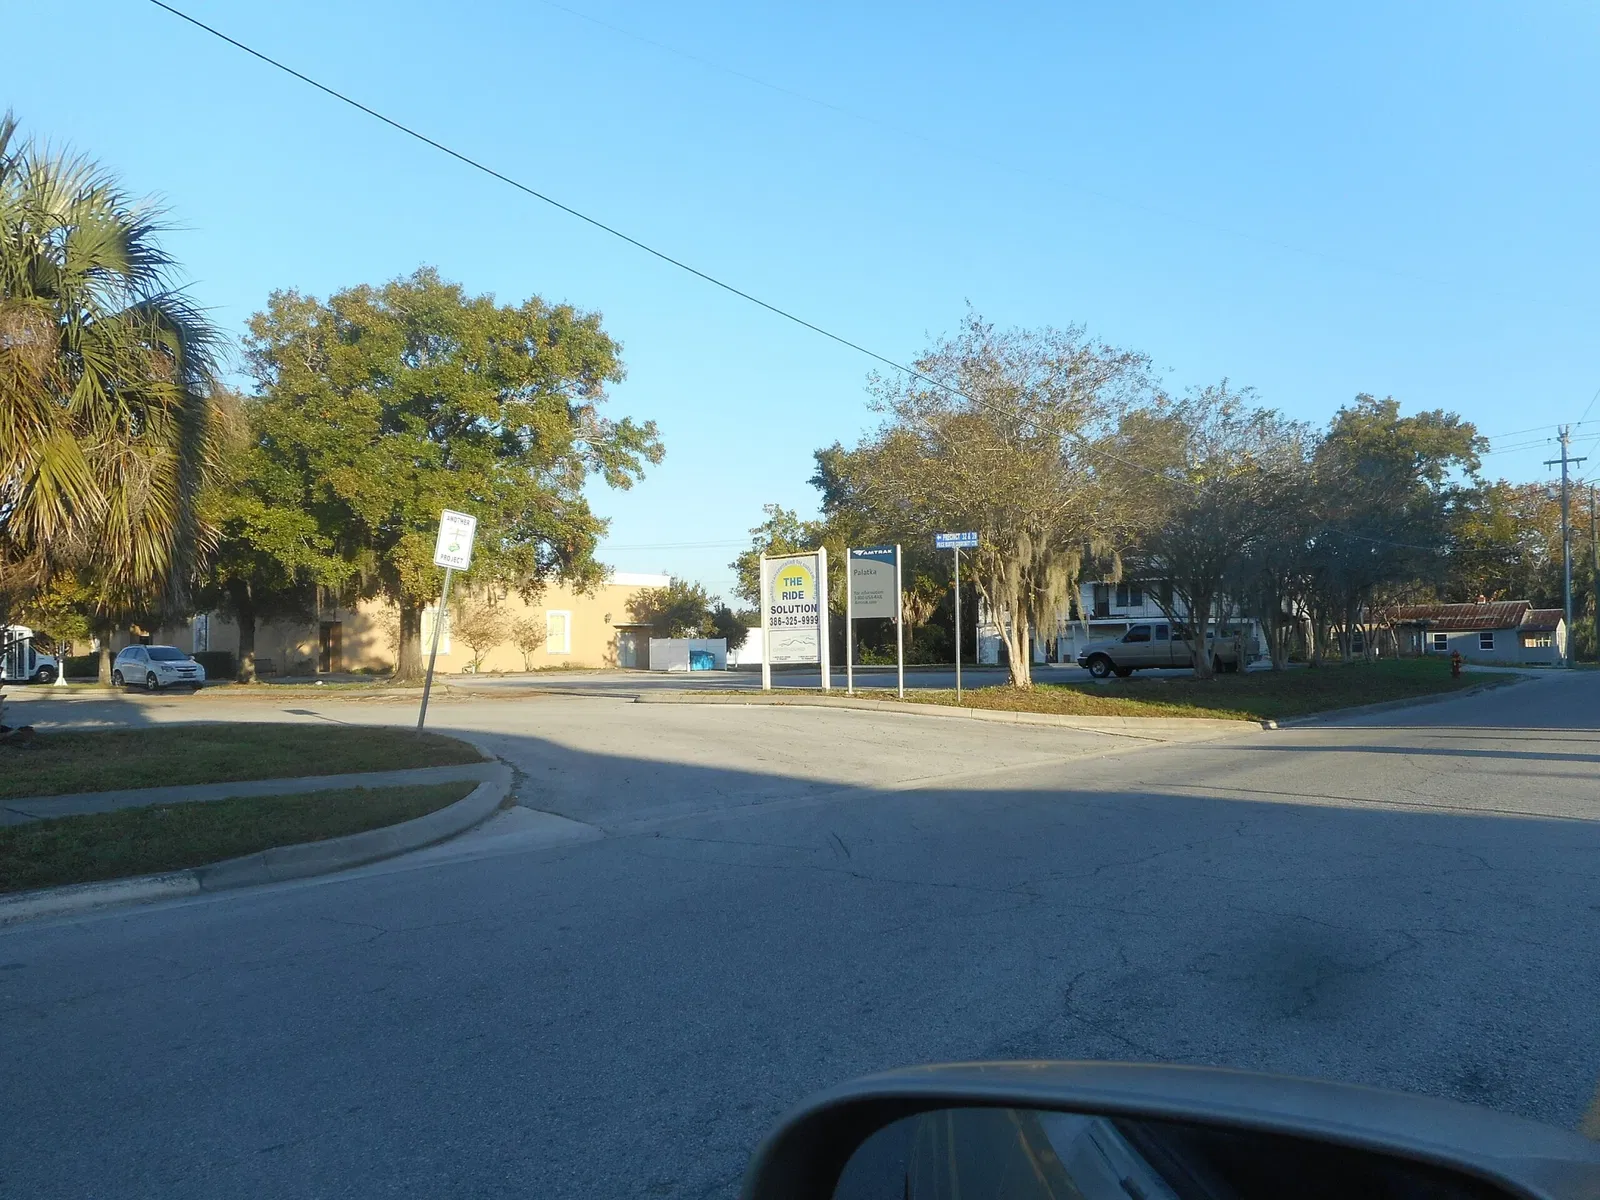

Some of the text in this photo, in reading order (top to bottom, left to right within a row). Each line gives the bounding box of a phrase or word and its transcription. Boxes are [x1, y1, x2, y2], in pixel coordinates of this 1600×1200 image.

[447, 515, 470, 526] ANOTHER
[440, 553, 463, 564] PROJECT
[853, 568, 877, 576] Palatka
[783, 577, 803, 587] THE
[782, 591, 804, 600] RIDE
[770, 604, 817, 614] SOLUTION
[770, 616, 819, 626] 386-325-9999
